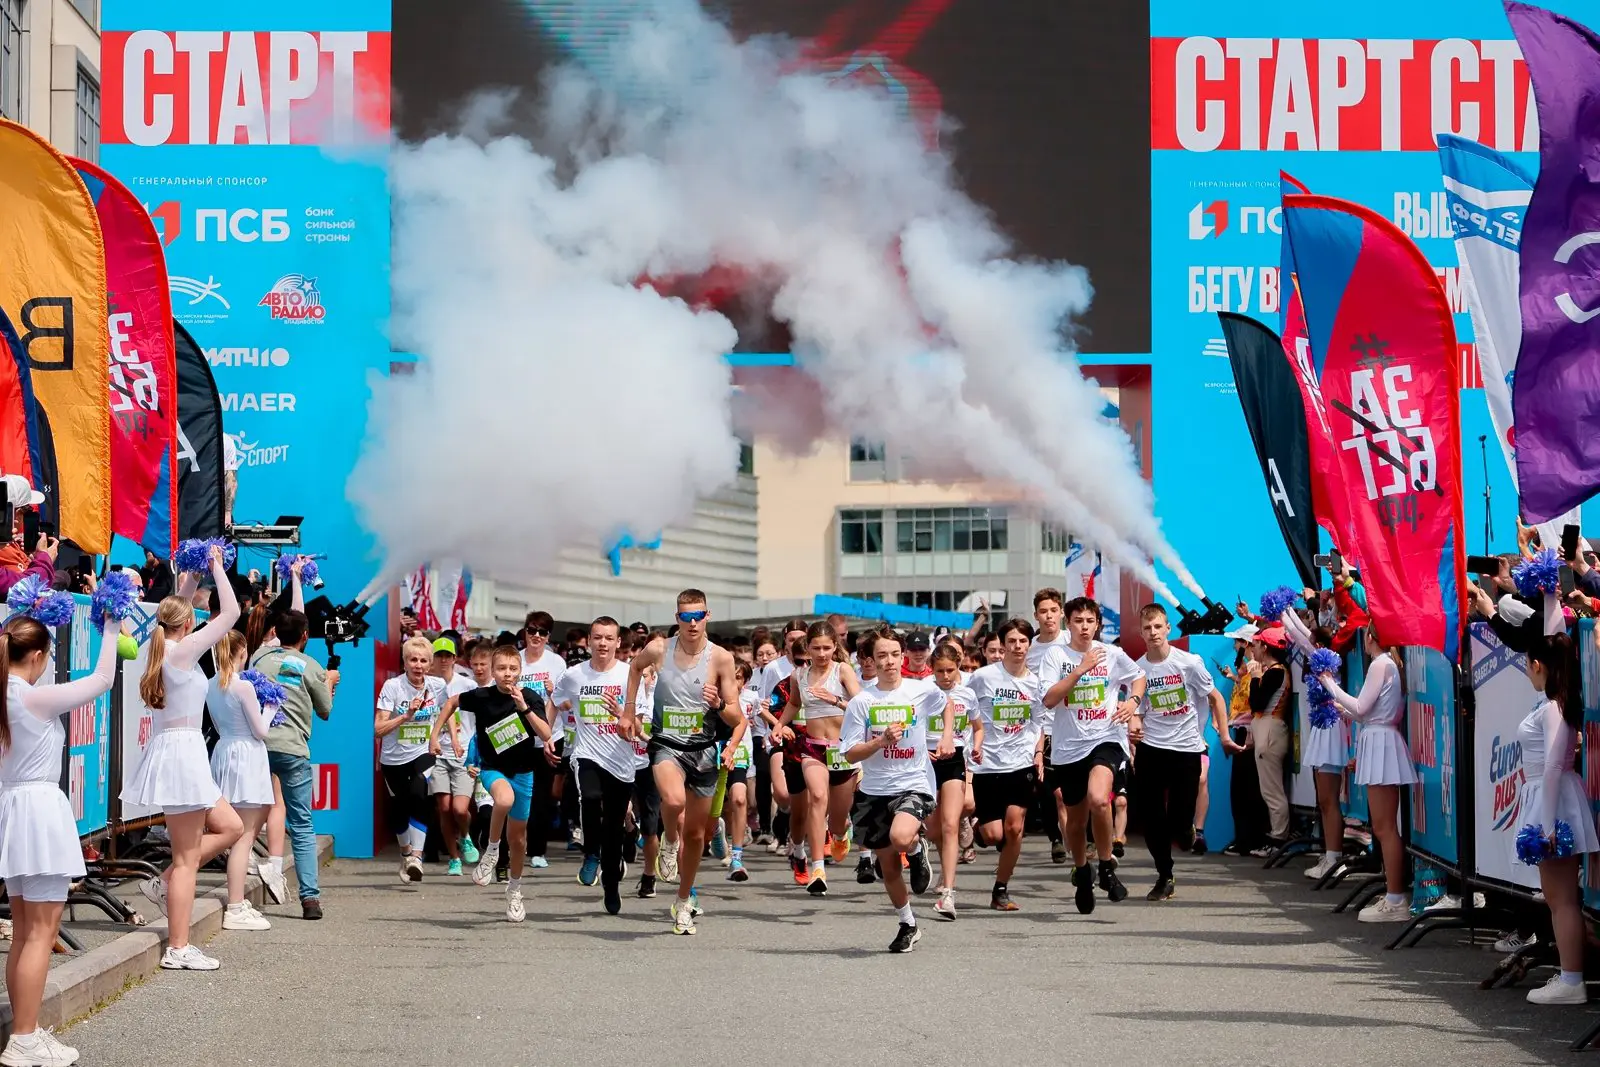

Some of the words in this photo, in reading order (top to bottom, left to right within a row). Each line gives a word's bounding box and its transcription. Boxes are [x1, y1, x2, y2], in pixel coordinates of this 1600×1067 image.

[122, 30, 368, 146] СТАРТ
[1175, 36, 1414, 152] СТАРТ
[132, 175, 213, 186] ГЕНЕРАЛЬНЫЙ
[216, 177, 268, 186] СПОНСОР
[195, 207, 290, 243] ПСБ
[305, 206, 335, 217] банк
[305, 218, 356, 231] сильной
[305, 231, 350, 243] страны
[1188, 265, 1255, 313] БЕГУ
[1259, 266, 1281, 313] В
[259, 292, 303, 305] АВТО
[271, 305, 326, 319] РАДИО
[247, 445, 289, 467] СПОРТ
[668, 714, 698, 728] 10334
